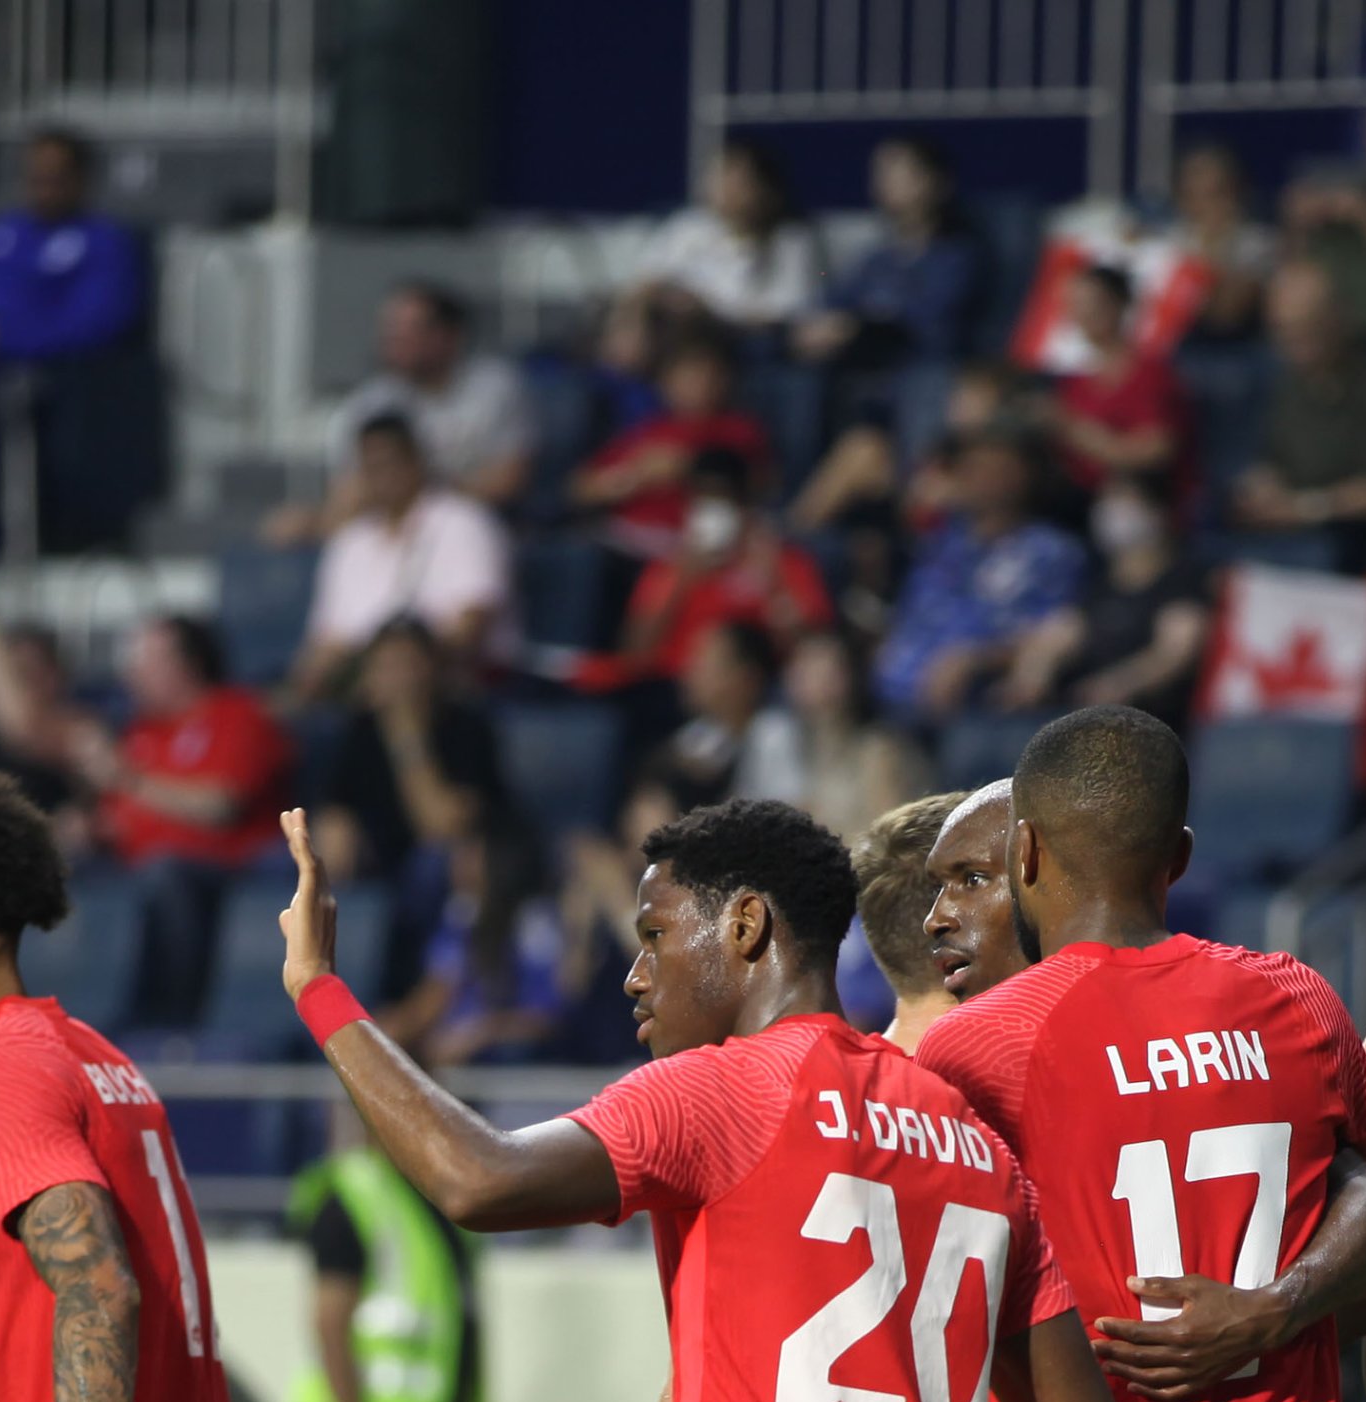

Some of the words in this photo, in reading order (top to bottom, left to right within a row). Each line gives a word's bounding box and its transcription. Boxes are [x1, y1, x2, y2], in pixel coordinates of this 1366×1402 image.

[1105, 1030, 1271, 1095] LARIN
[815, 1090, 861, 1143] J.
[865, 1099, 994, 1173] DAVID
[1110, 1122, 1292, 1381] 17
